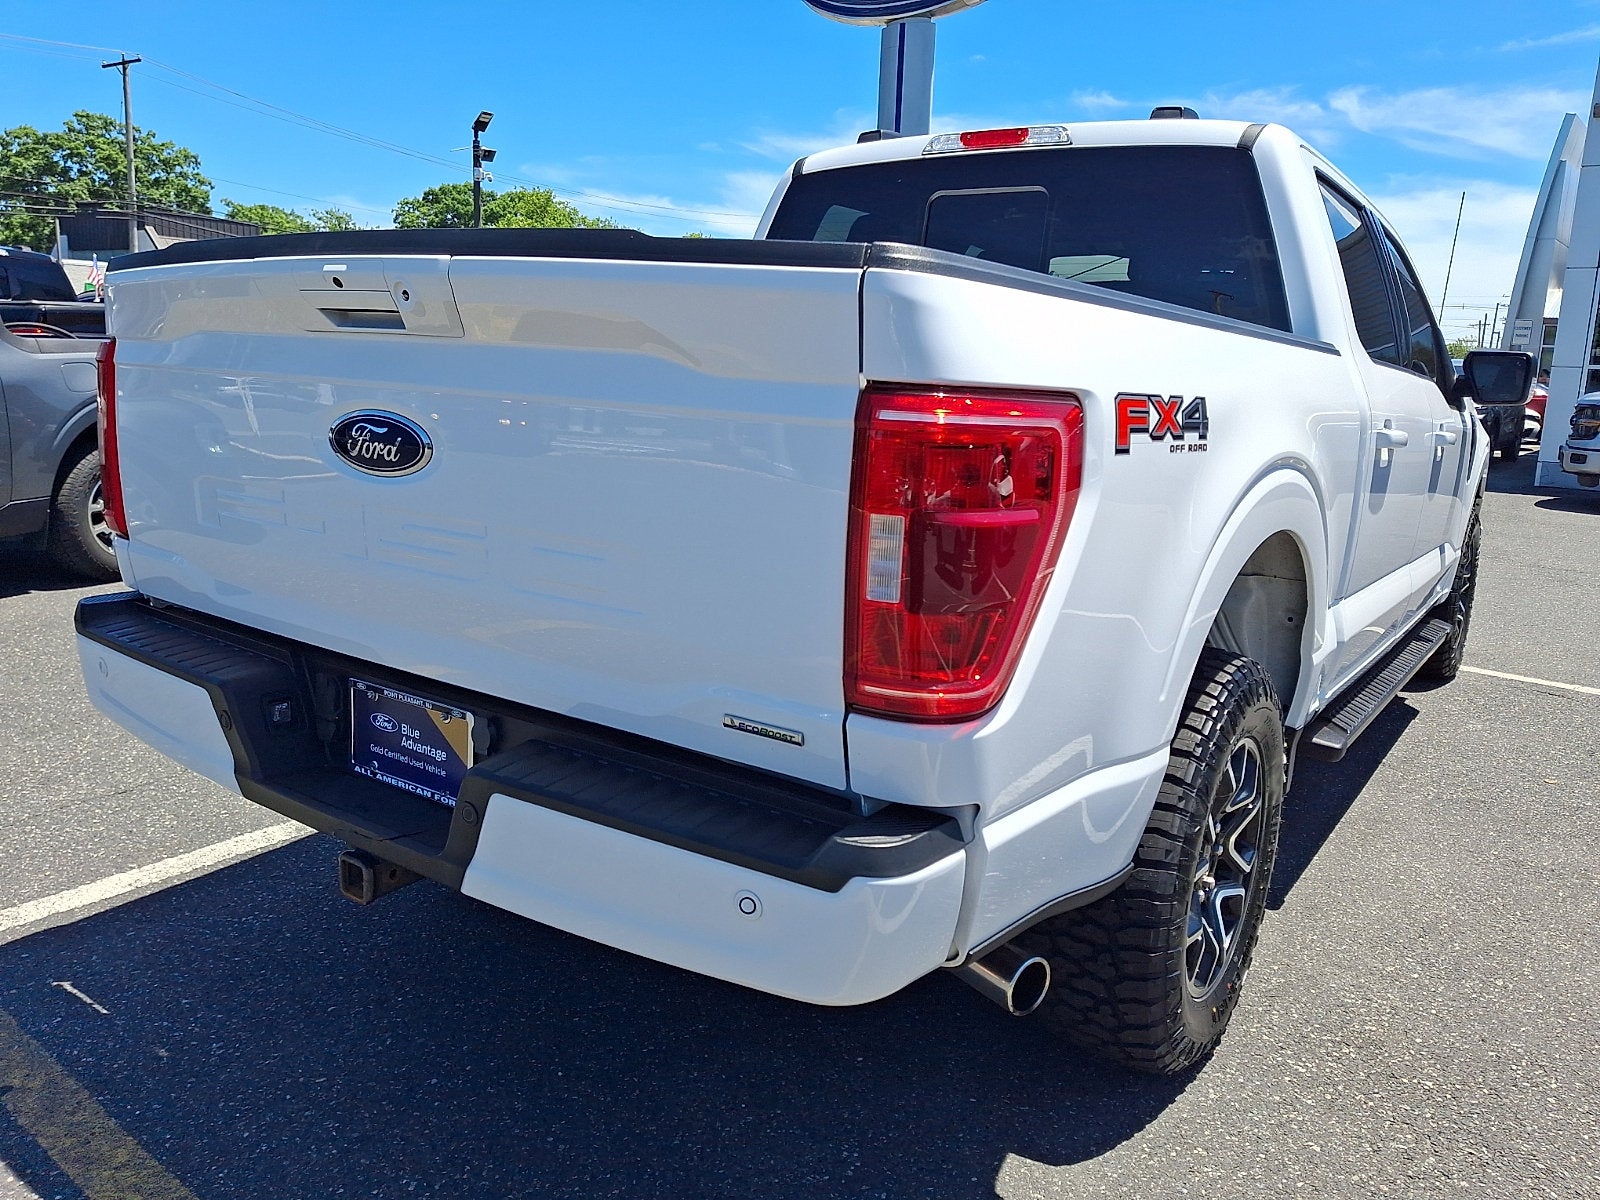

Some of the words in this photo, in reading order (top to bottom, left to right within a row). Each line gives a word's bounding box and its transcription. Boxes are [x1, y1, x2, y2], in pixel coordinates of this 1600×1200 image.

[1114, 392, 1209, 456] FX4
[347, 422, 402, 462] Ford
[1169, 444, 1185, 453] OFF
[1188, 443, 1208, 452] ROAD
[384, 689, 398, 700] POINT
[375, 714, 393, 730] Ford
[401, 723, 420, 739] Blue
[370, 743, 384, 755] Gold
[384, 749, 408, 764] Certified
[408, 756, 424, 770] Used
[424, 761, 447, 777] Vehicle
[401, 737, 447, 762] Advantage
[354, 765, 373, 777] ALL
[375, 773, 432, 798] AMERICAN
[434, 794, 456, 807] FOR
